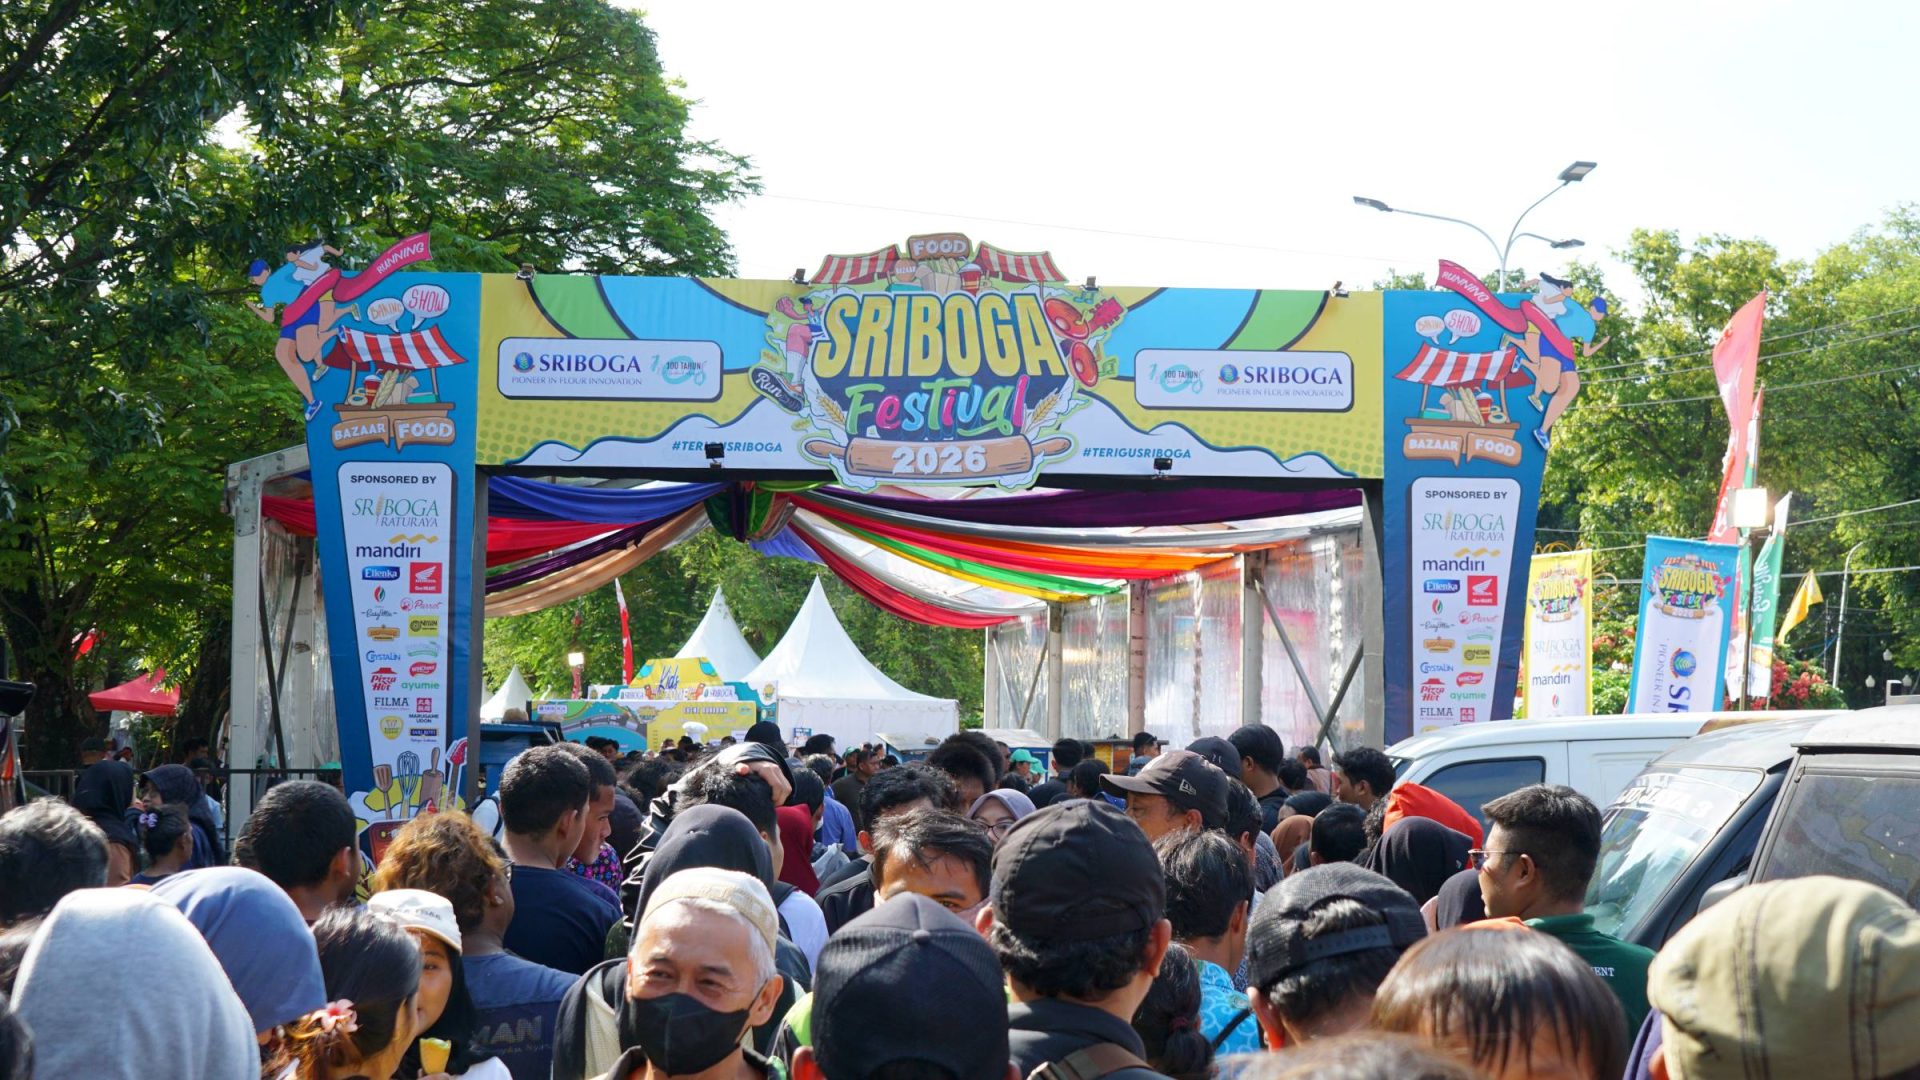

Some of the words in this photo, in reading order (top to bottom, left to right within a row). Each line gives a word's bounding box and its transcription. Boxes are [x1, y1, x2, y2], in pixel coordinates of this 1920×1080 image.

[912, 239, 967, 256] FOOD
[377, 242, 425, 274] RUNNING
[1441, 271, 1489, 303] RUNNING
[408, 288, 446, 313] SHOW
[1448, 312, 1478, 333] SHOW
[813, 293, 1067, 379] SRIBOGA
[539, 354, 641, 373] SRIBOGA
[511, 376, 546, 384] PIONEER
[548, 377, 557, 385] IN
[559, 377, 587, 385] FLOUR
[588, 378, 643, 386] INNOVATION
[1244, 366, 1343, 385] SRIBOGA
[755, 372, 783, 398] Run
[1217, 388, 1251, 396] PIONEER
[1253, 388, 1262, 396] IN
[1263, 389, 1291, 397] FLOUR
[1292, 389, 1344, 397] INNOVATION
[844, 374, 1031, 438] Festival
[334, 422, 387, 439] BAZAAR
[399, 420, 454, 439] FOOD
[672, 440, 783, 452] #TERSRIBOGA
[1408, 438, 1458, 450] BAZAAR
[1475, 439, 1516, 457] FOOD
[891, 444, 988, 475] 2026
[1082, 447, 1191, 459] #TERIGUSRIBOGA
[351, 475, 419, 484] SPONSORED
[422, 475, 437, 485] BY
[1425, 490, 1491, 499] SPONSORED
[1493, 491, 1508, 500] BY
[381, 516, 439, 527] RATURAYA
[1450, 531, 1505, 542] RATURAYA
[356, 543, 421, 558] mandiri
[1422, 557, 1485, 571] mandiri
[365, 568, 398, 578] Ellenka
[1659, 566, 1716, 595] SRIBOGA
[1663, 589, 1707, 609] Festival
[1654, 643, 1667, 691] PIONEER
[370, 674, 397, 685] Pizza
[401, 681, 440, 691] ayumie
[1532, 673, 1571, 686] mandiri
[372, 683, 391, 691] Hut
[1420, 685, 1445, 695] Pizza
[374, 697, 409, 706] FILMA
[1422, 693, 1440, 701] Hut
[1450, 692, 1487, 701] ayumie
[1652, 693, 1661, 706] IN
[1420, 707, 1454, 717] FILMA
